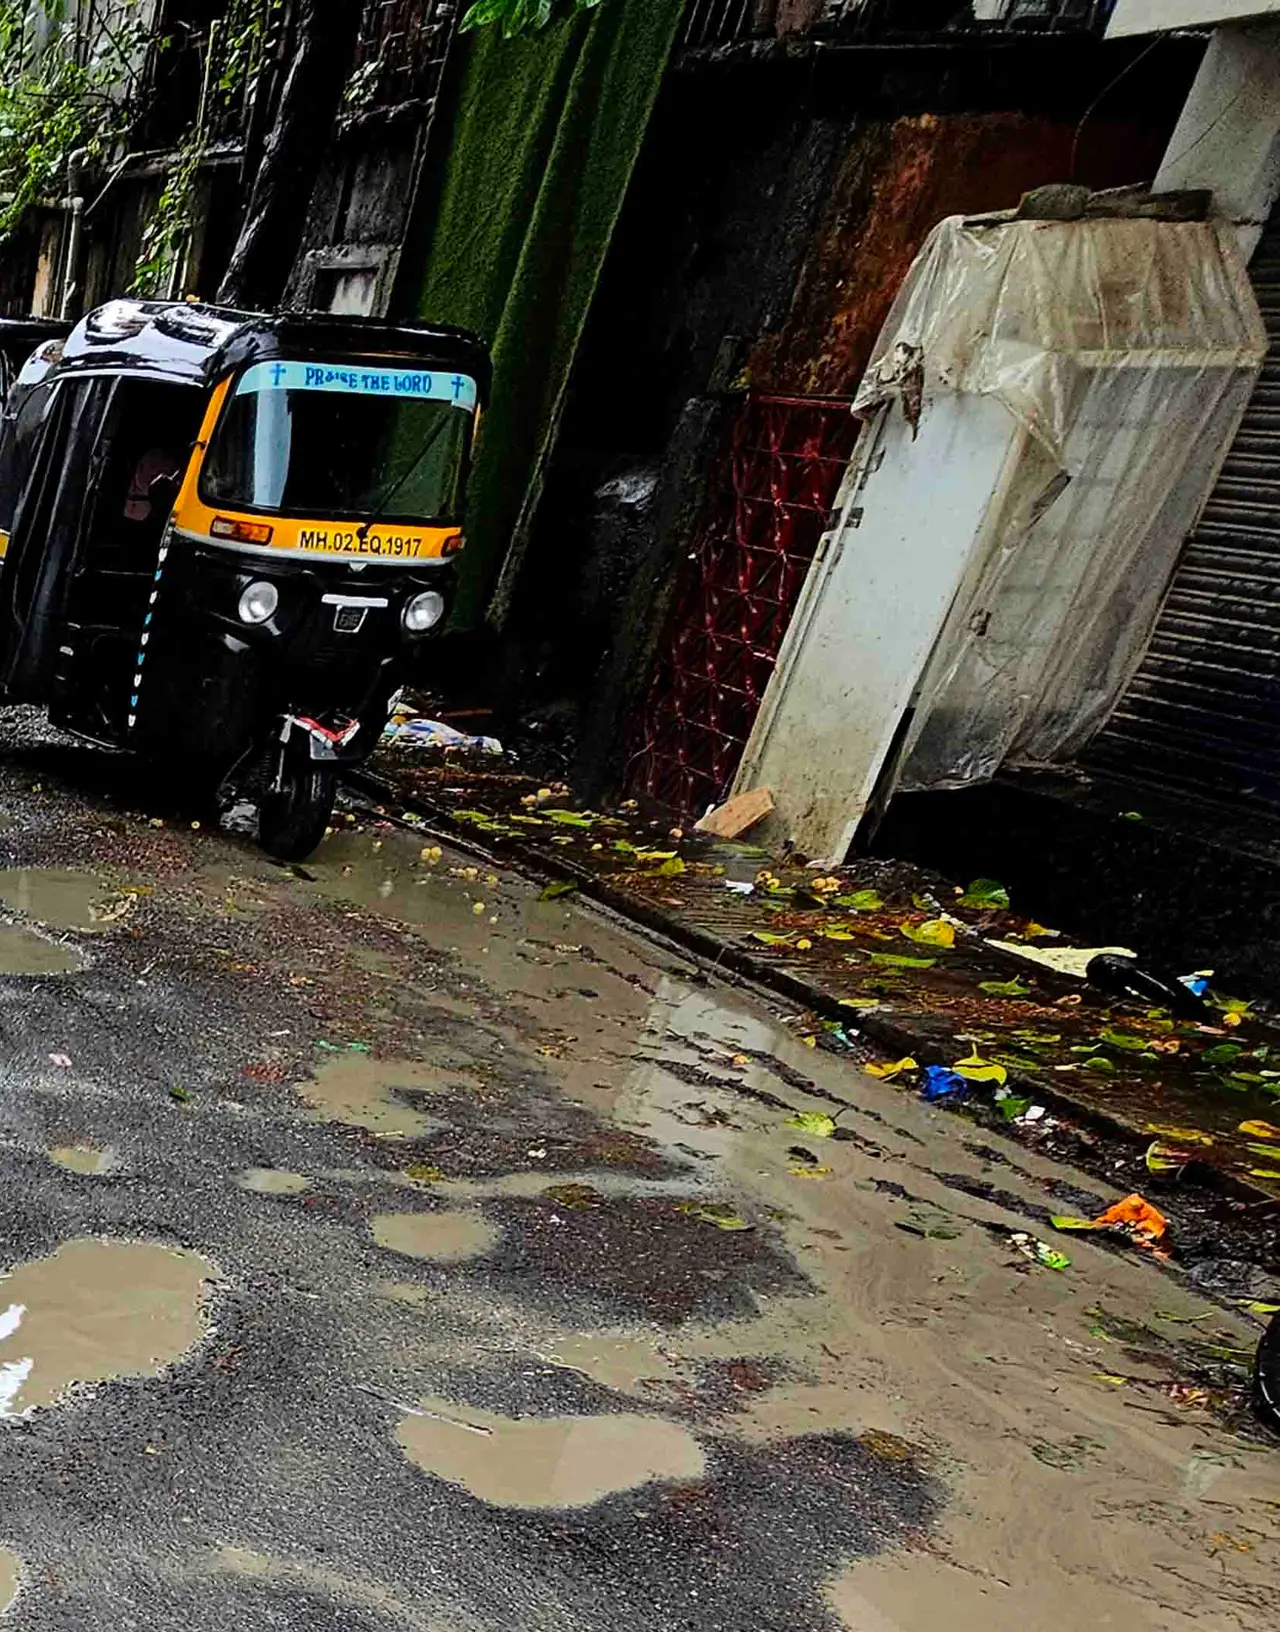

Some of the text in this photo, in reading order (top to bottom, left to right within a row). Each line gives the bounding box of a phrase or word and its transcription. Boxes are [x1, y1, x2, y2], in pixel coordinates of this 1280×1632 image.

[361, 375, 390, 390] THE
[394, 374, 432, 393] LORD
[300, 531, 422, 557] MH.02.EQ.1917
